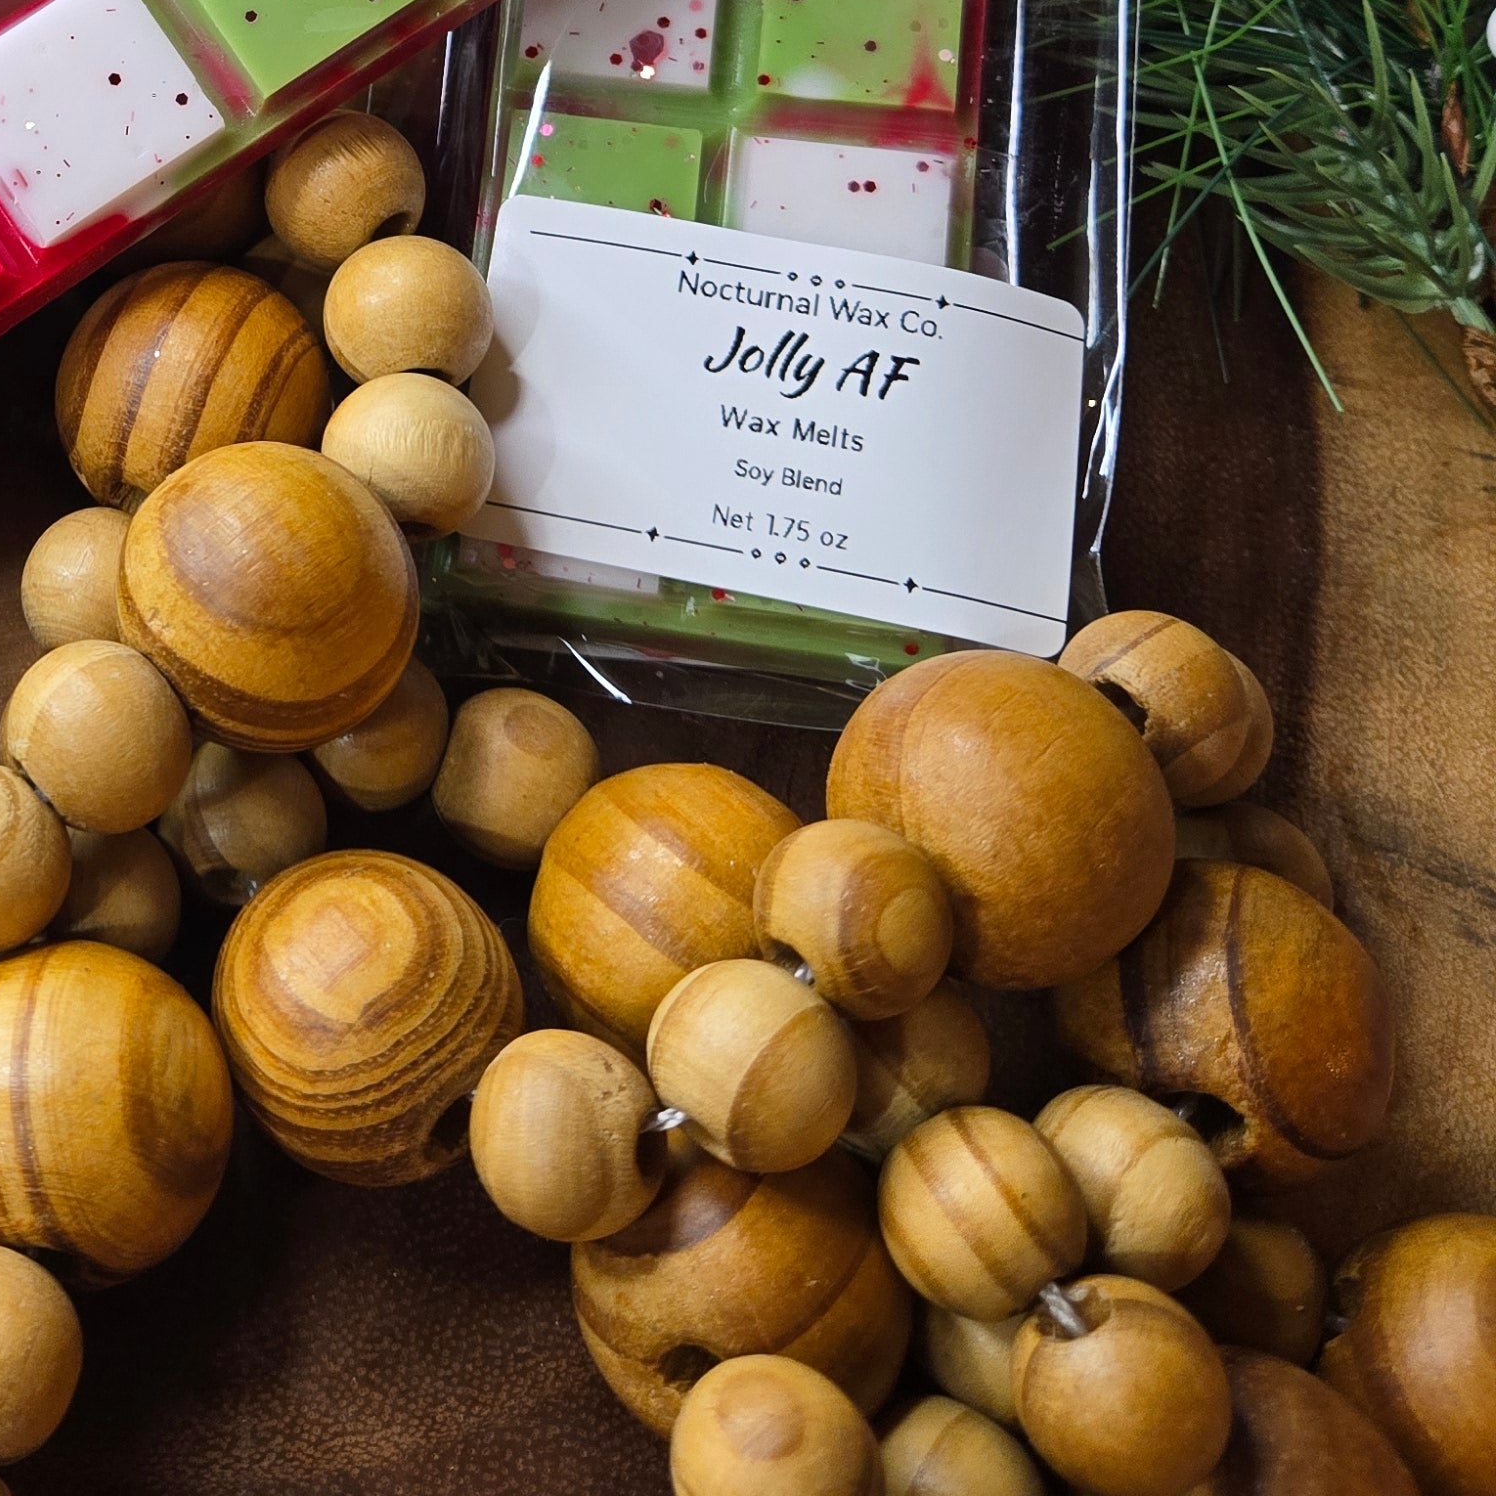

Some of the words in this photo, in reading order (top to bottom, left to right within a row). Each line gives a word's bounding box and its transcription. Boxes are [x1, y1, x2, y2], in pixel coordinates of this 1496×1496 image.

[678, 270, 820, 317] Nocturnal
[829, 295, 890, 330] Wax
[900, 310, 944, 339] Co.
[704, 326, 825, 399] Jolly
[836, 350, 920, 400] AF
[720, 404, 780, 437] Wax
[792, 418, 865, 453] Melts
[734, 458, 775, 488] Soy
[781, 466, 843, 496] Blend
[712, 503, 754, 532] Net
[766, 513, 811, 542] 1.75
[819, 531, 850, 551] oz
